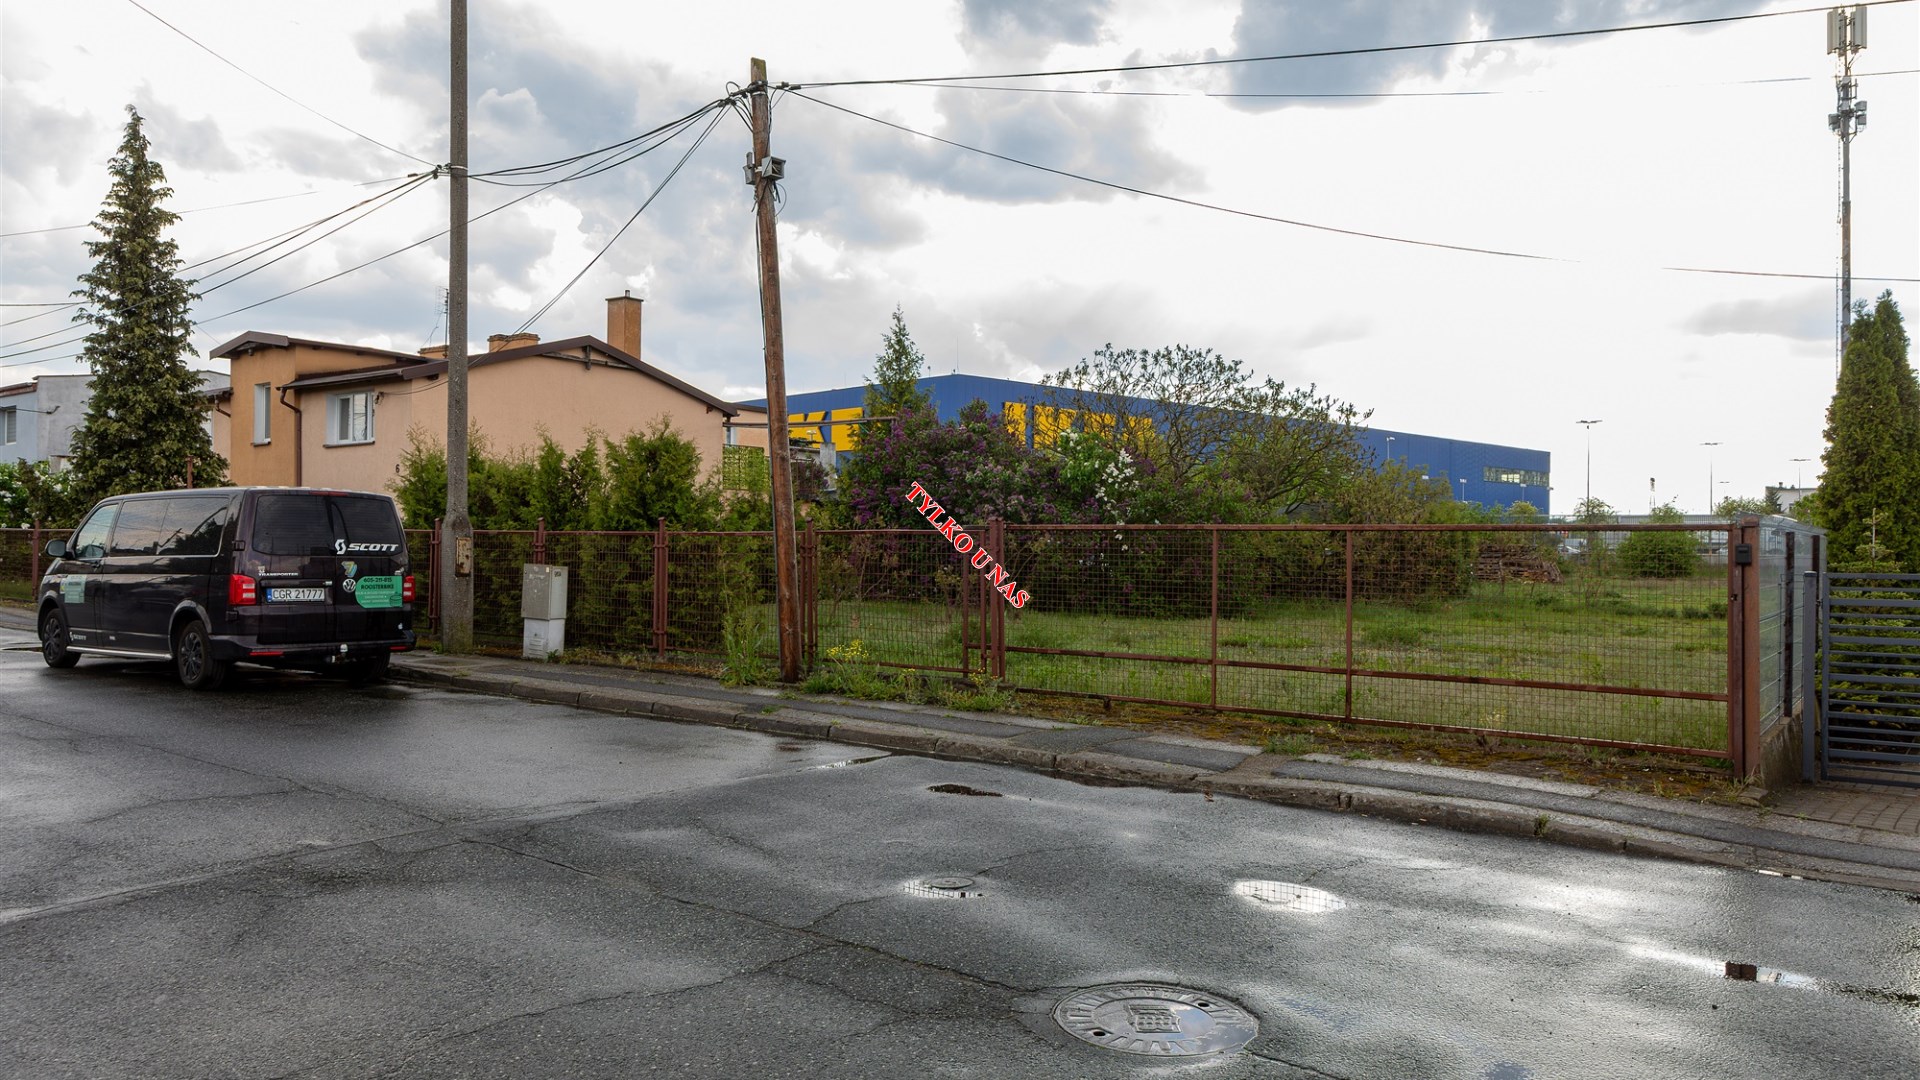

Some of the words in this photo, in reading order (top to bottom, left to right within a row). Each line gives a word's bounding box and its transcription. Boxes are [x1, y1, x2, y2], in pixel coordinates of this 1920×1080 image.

[395, 463, 400, 474] 6
[347, 543, 399, 552] SCOTT
[272, 589, 292, 599] CGR
[294, 589, 323, 599] 21777
